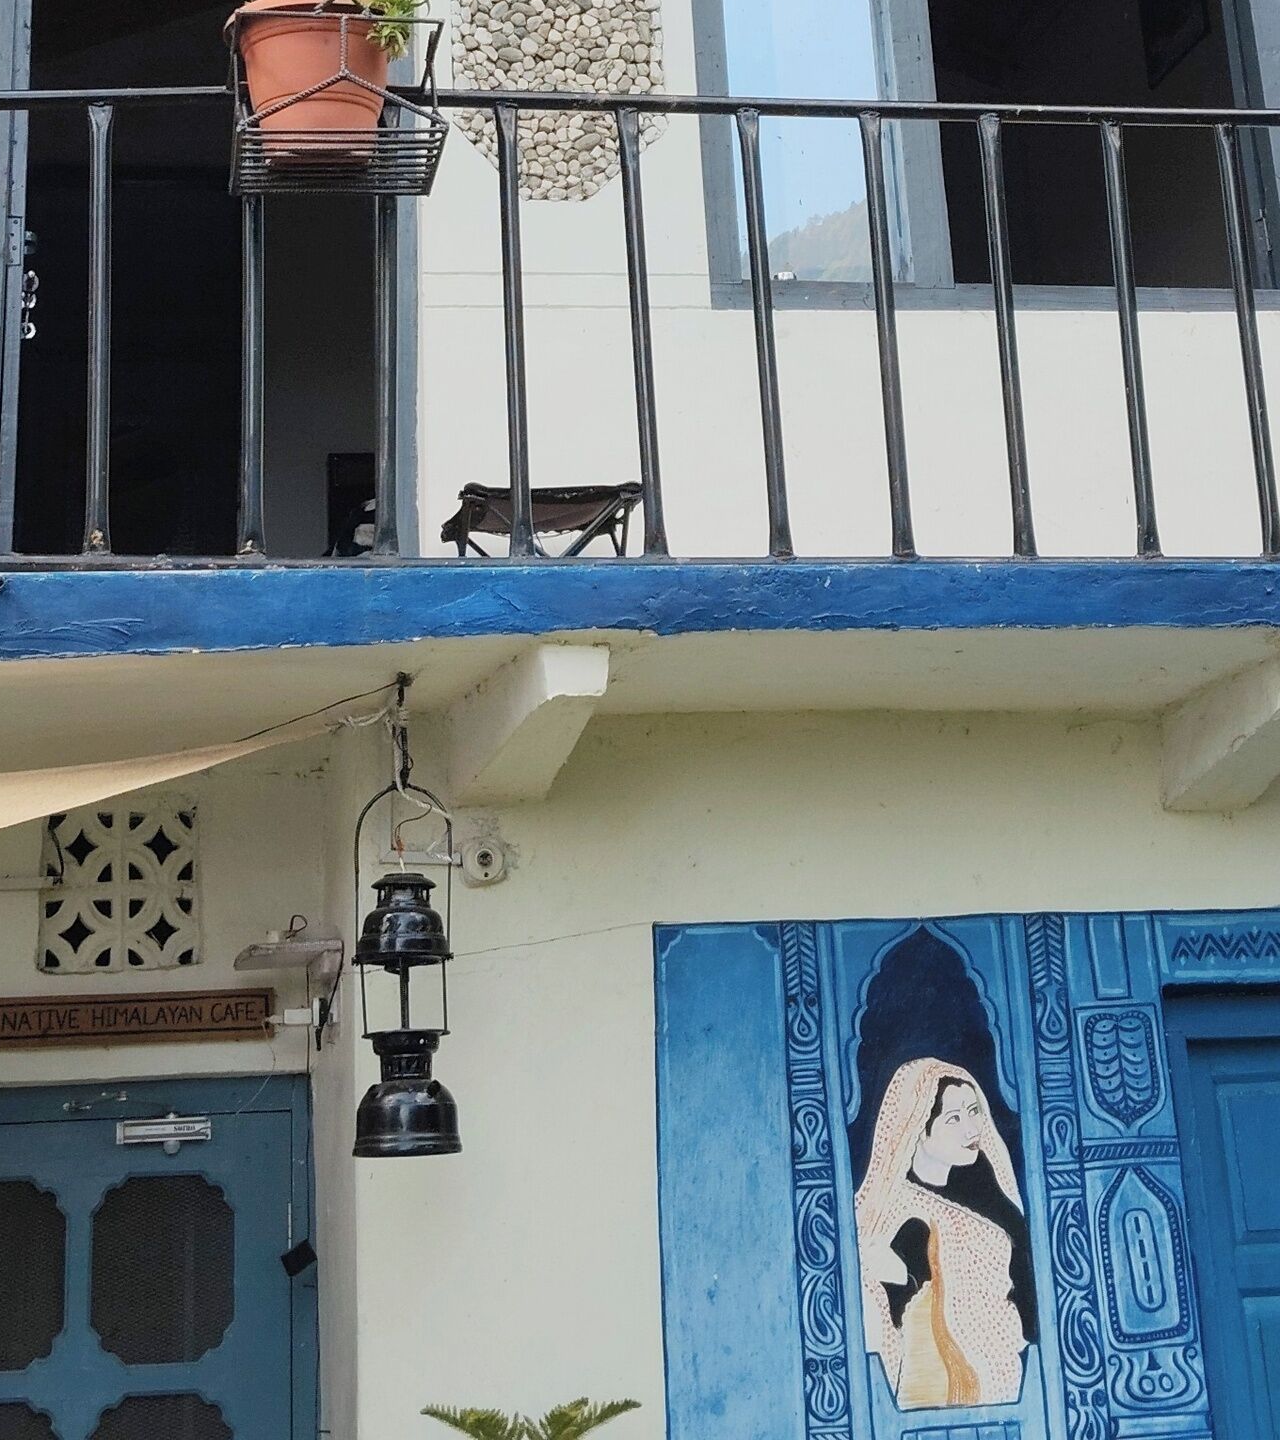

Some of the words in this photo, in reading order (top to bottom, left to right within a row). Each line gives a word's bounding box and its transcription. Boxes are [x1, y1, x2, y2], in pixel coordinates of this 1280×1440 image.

[1, 1008, 81, 1033] NATIVE
[92, 1004, 203, 1028] HIMALAYAN
[210, 1000, 258, 1024] CAFE
